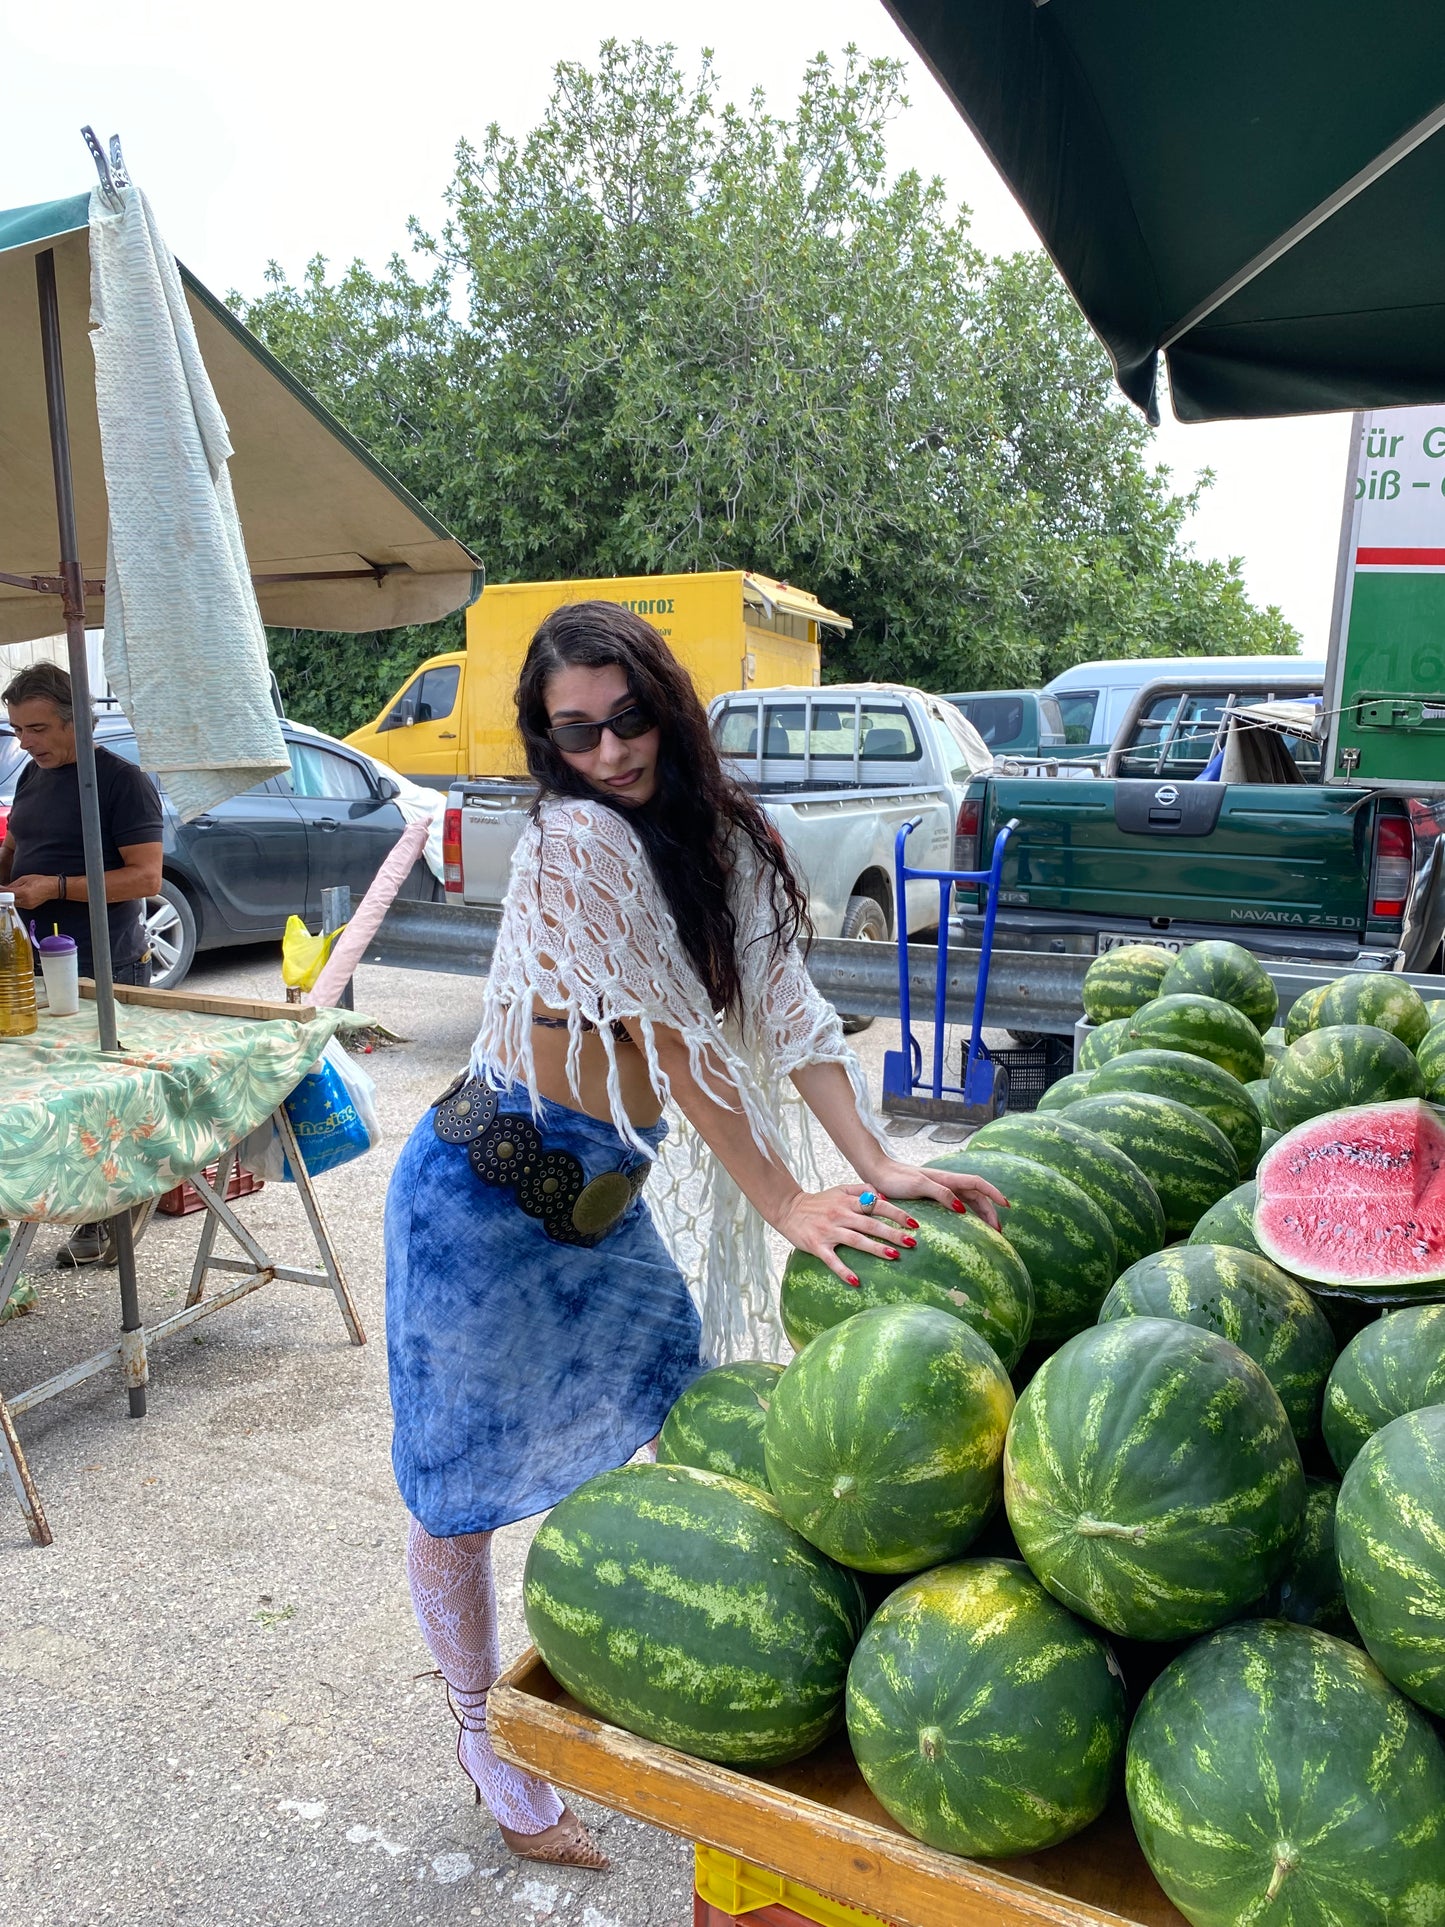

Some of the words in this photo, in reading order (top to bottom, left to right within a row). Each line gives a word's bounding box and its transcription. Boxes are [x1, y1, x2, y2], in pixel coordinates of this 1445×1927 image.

[1361, 428, 1404, 458] ür
[615, 599, 675, 615] ΑΓΩΓΟΣ
[468, 815, 500, 824] TOYOTA
[1230, 909, 1303, 923] NAVARA
[1308, 914, 1338, 925] 2.5
[1341, 917, 1360, 927] Di
